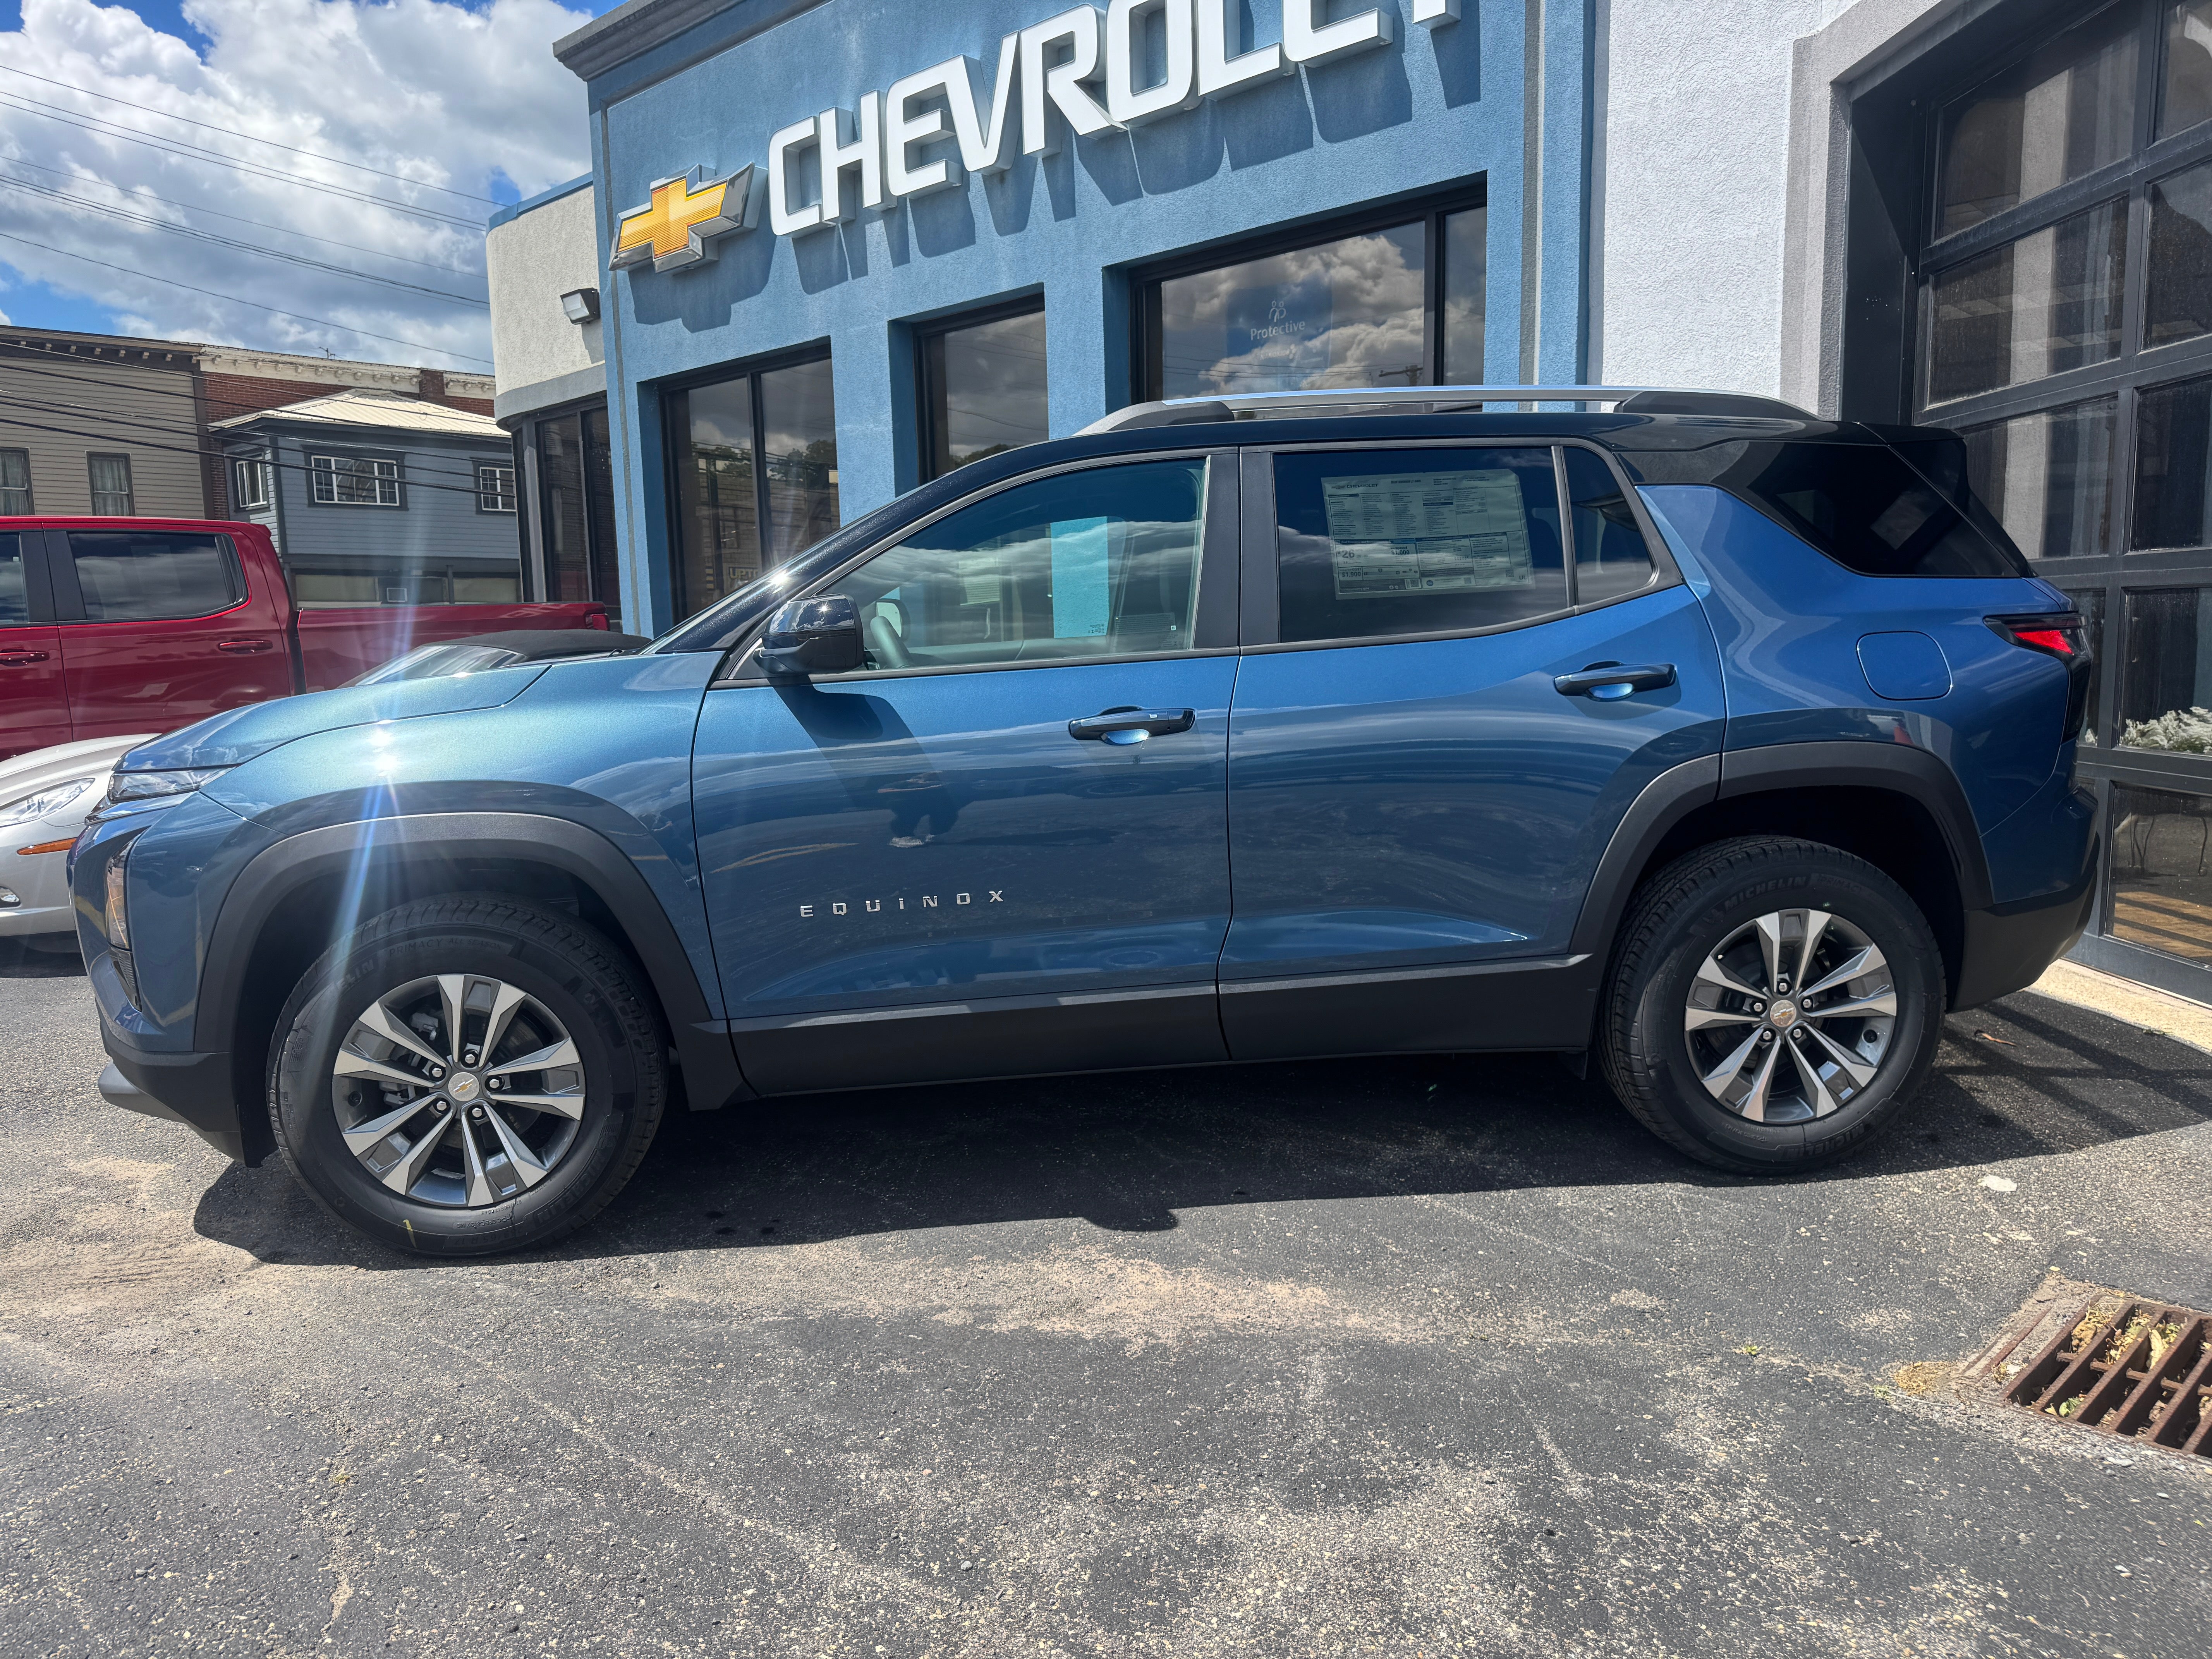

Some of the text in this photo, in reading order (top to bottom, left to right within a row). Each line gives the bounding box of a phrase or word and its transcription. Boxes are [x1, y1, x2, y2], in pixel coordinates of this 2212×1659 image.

[768, 0, 1447, 236] CHEVROL
[1250, 321, 1305, 341] Protective
[1342, 549, 1355, 558] 26
[800, 890, 1004, 917] EQUINOX
[1724, 876, 1807, 910] MICHELIN
[389, 938, 443, 957] PRIMACY
[467, 939, 503, 950] SEASON
